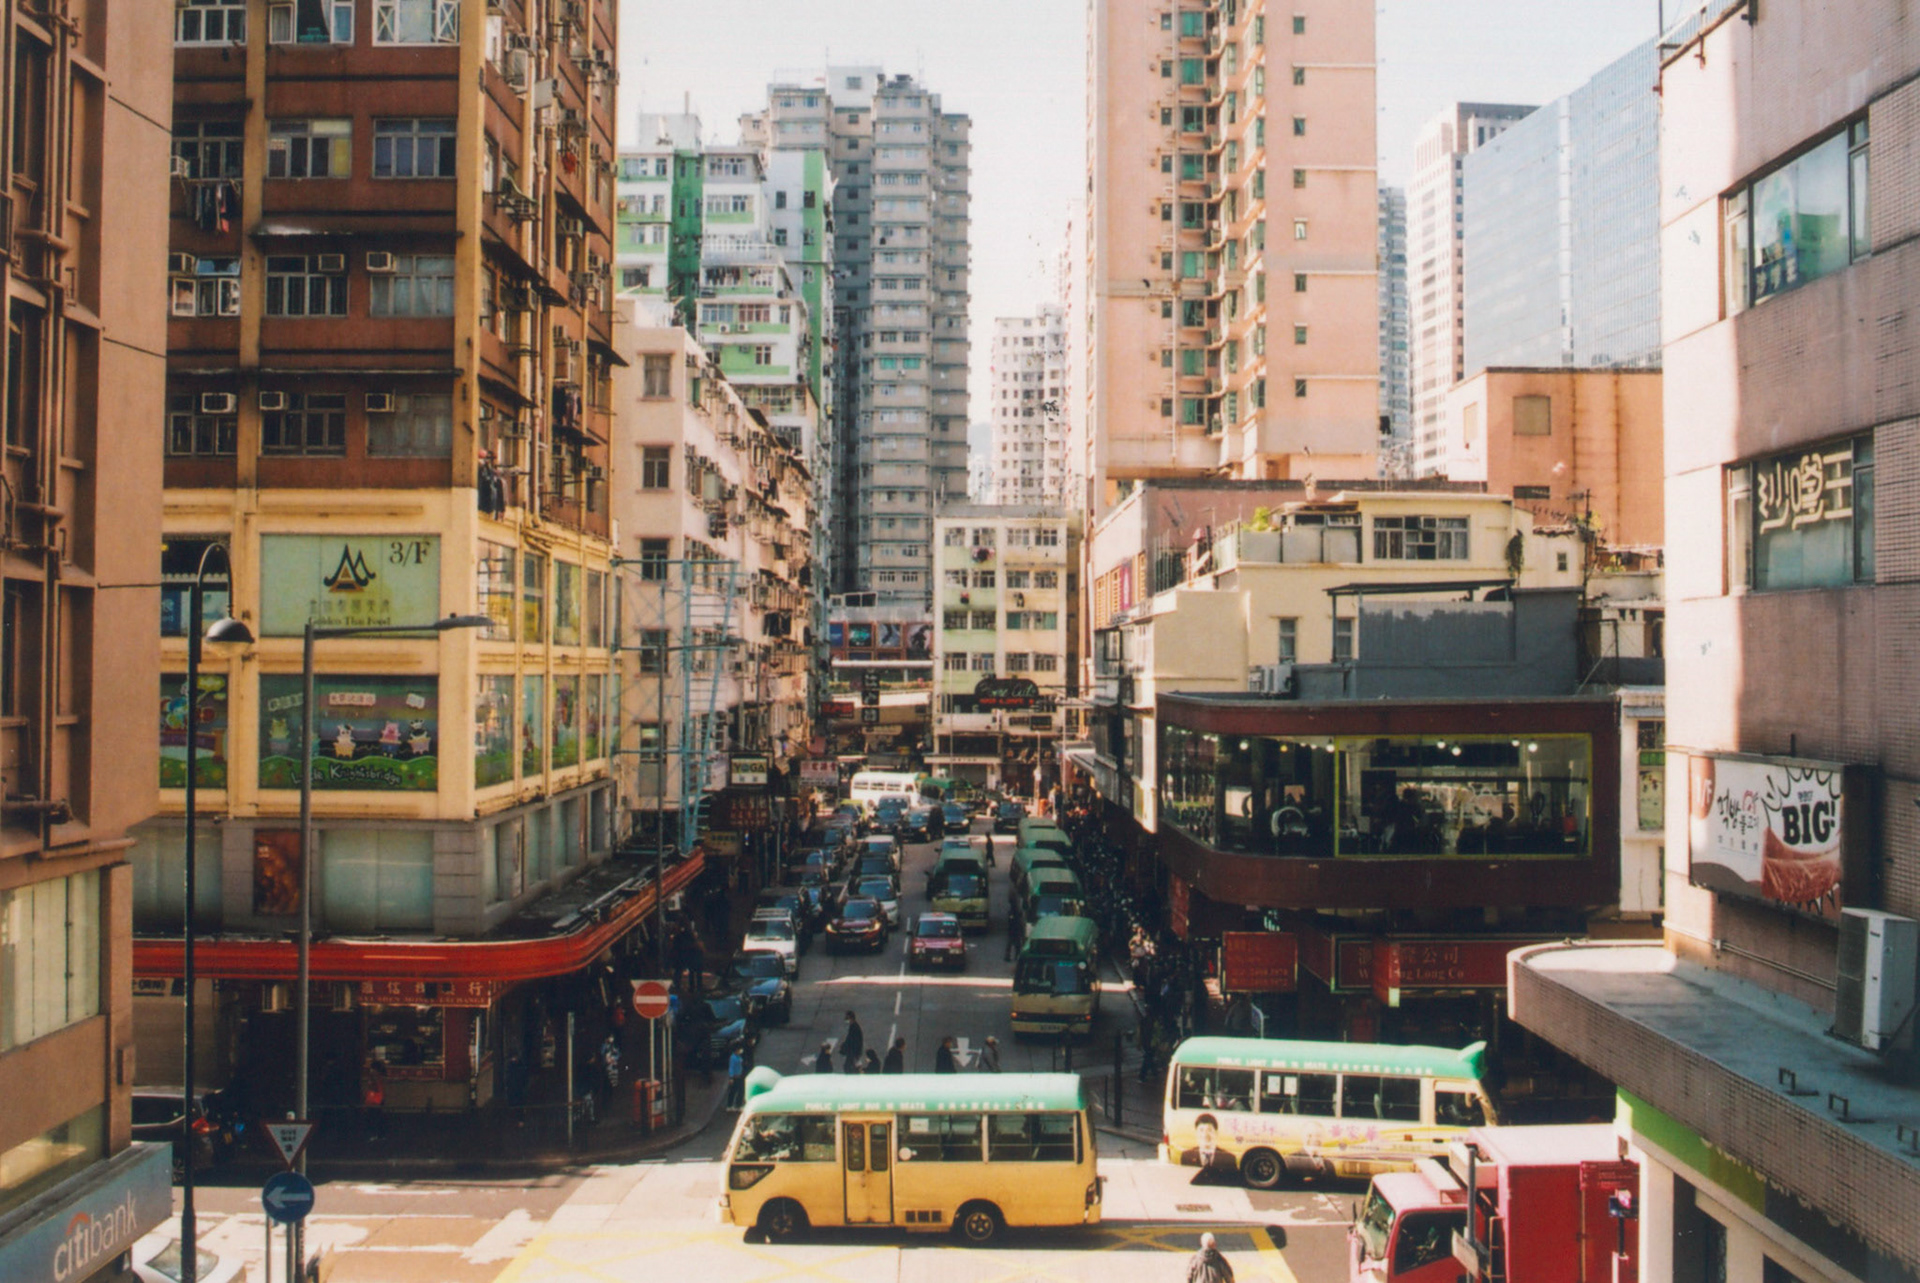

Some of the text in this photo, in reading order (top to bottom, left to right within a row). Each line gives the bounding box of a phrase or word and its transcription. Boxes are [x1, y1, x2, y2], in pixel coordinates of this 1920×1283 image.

[389, 541, 431, 567] 3/F
[291, 764, 402, 785] Ltle Knightsbridge
[1781, 800, 1836, 846] BIG!
[280, 1128, 297, 1136] GIVE
[54, 1188, 138, 1282] citibank
